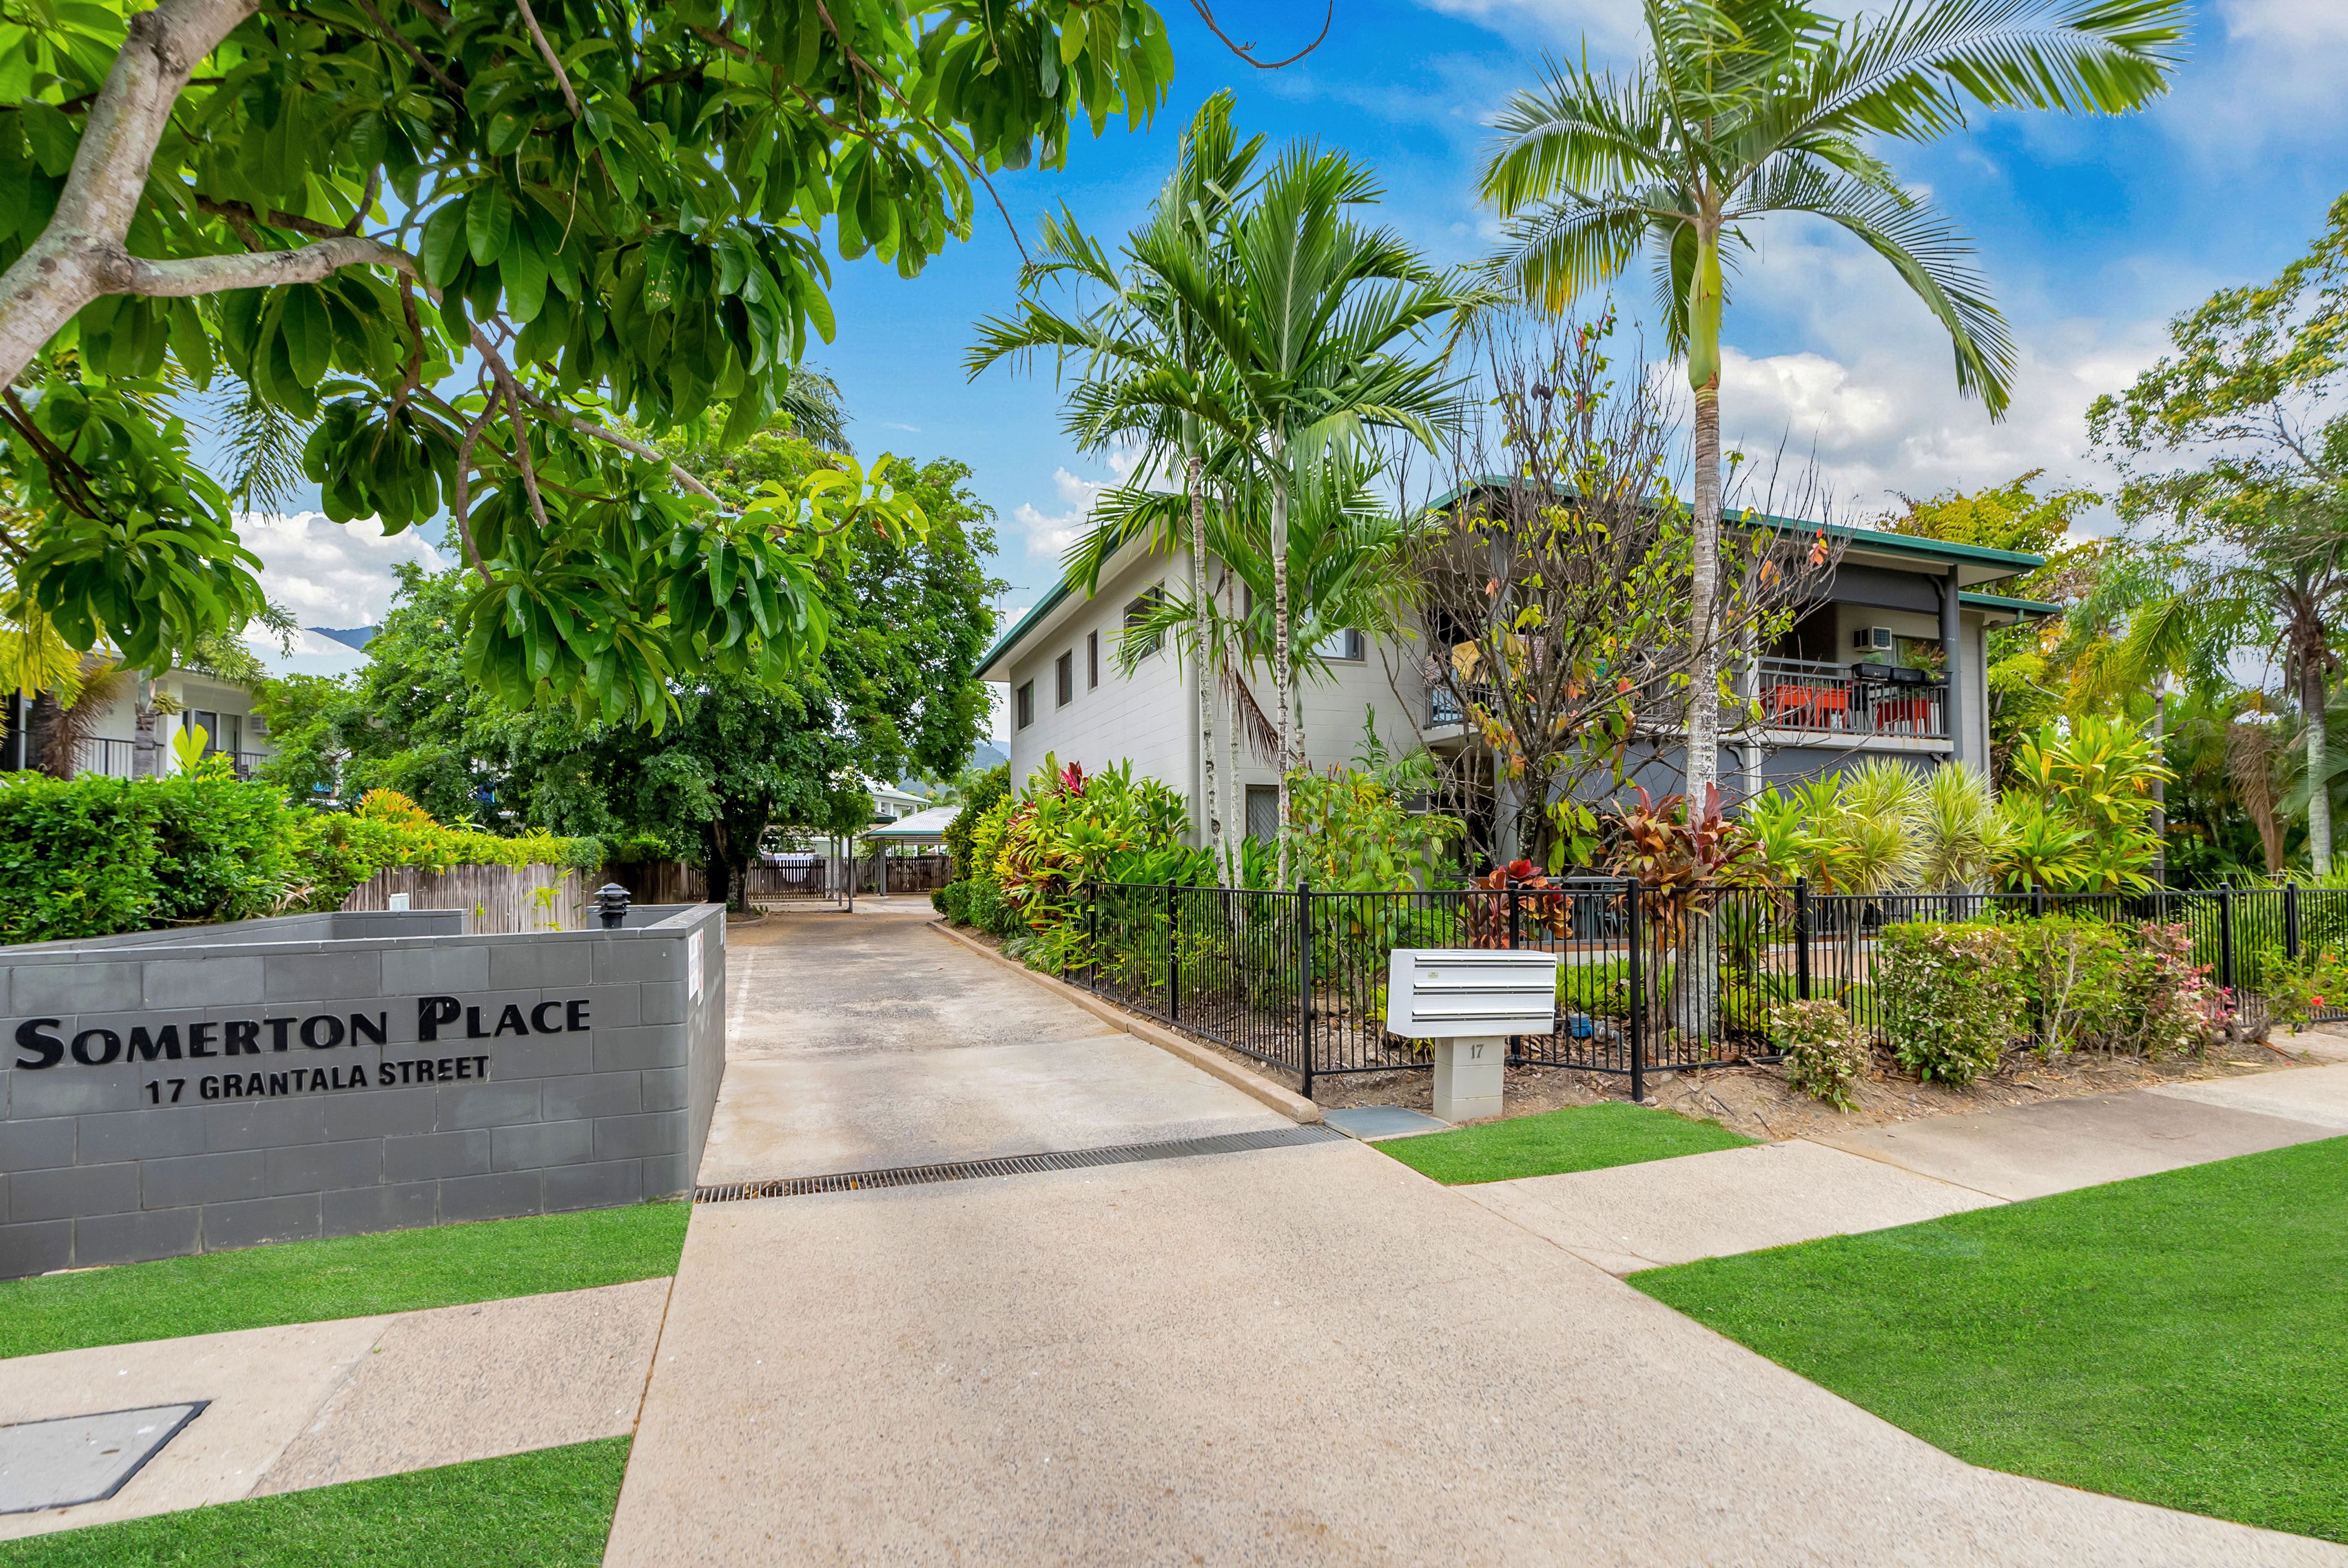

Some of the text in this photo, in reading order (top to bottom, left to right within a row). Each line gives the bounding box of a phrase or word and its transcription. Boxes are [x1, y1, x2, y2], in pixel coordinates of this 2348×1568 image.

[14, 996, 591, 1070] SOMERTON PLACE
[1471, 1044, 1484, 1059] 17
[145, 1055, 490, 1104] 17 GRANTALA STREET
